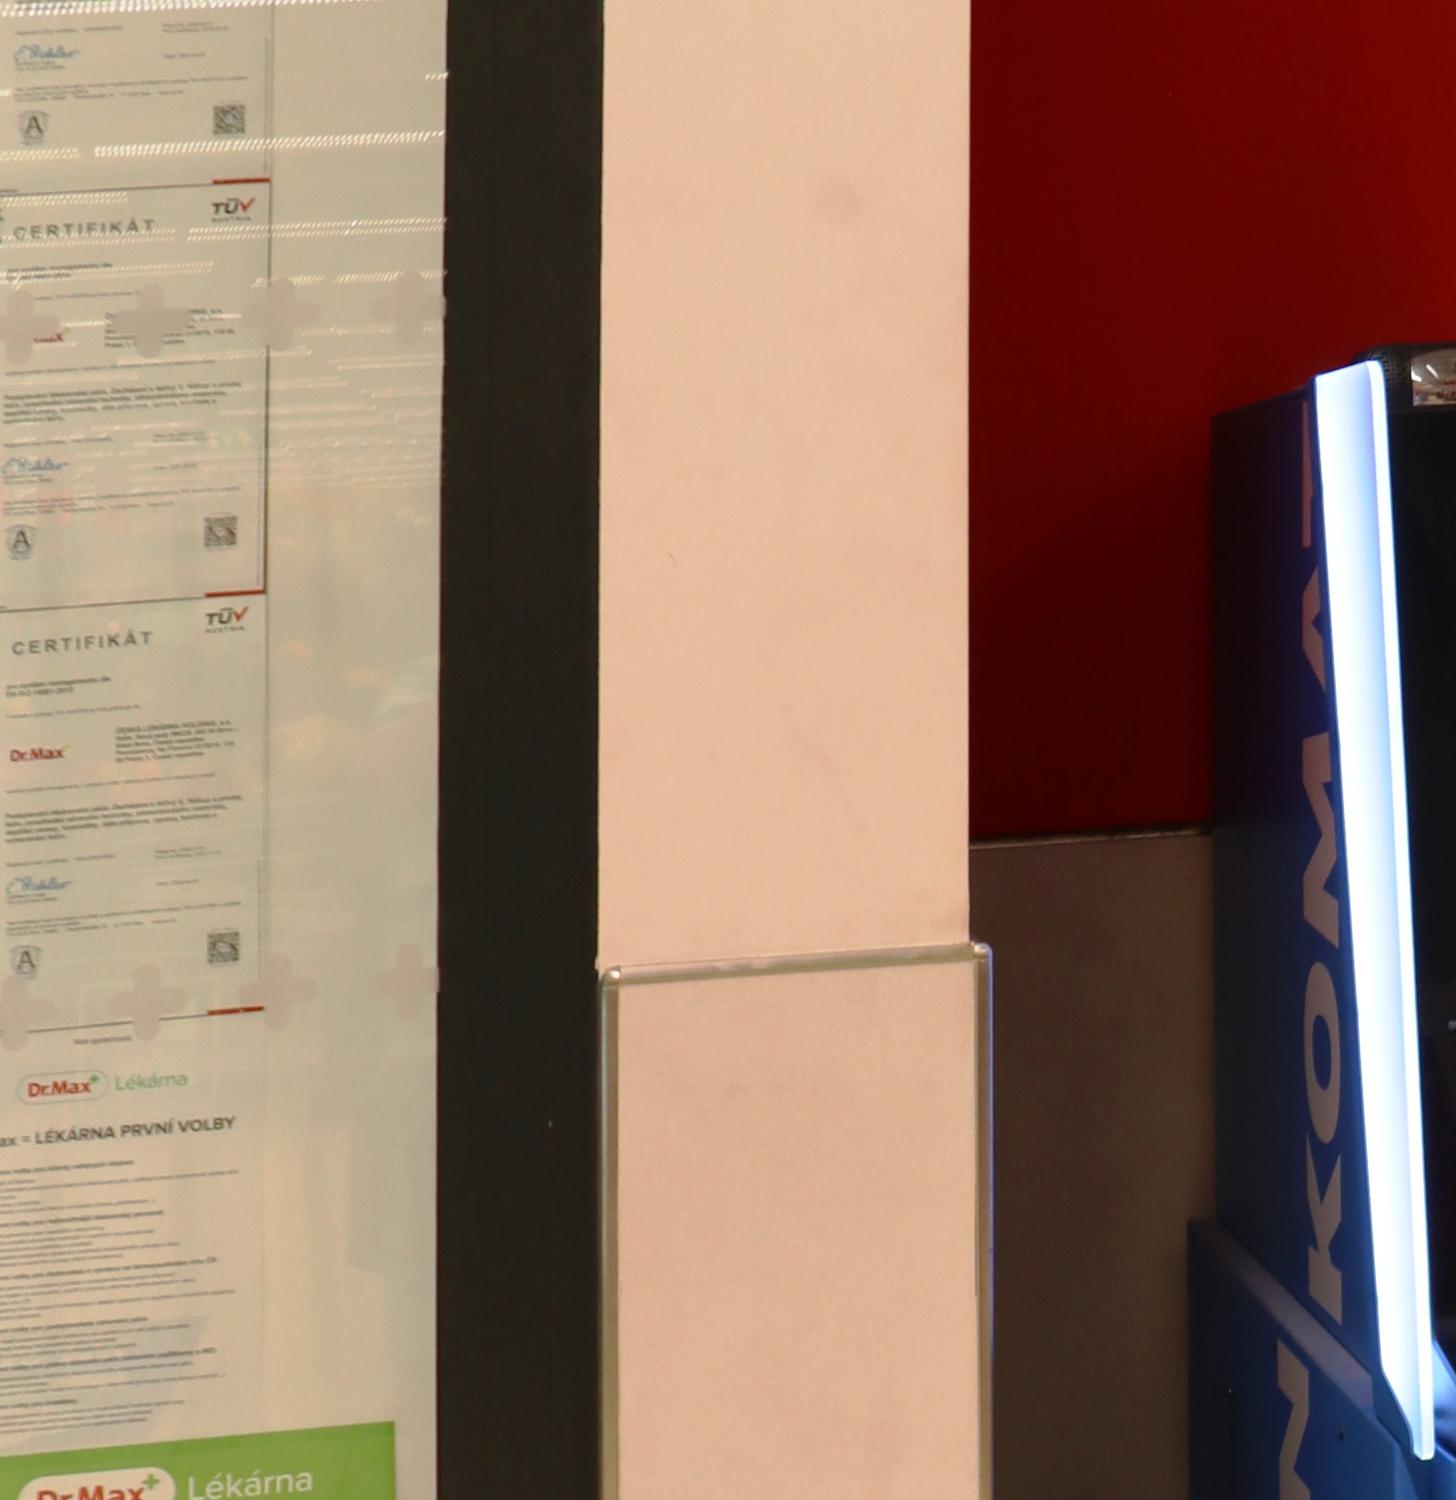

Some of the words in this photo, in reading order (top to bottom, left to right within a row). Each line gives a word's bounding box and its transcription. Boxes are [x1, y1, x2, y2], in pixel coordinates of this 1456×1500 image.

[13, 217, 156, 241] CERTIFIKÁT
[12, 629, 153, 656] CERTIFIKÁT
[10, 747, 64, 762] Dr.Max
[27, 1080, 91, 1098] Dr.Max
[115, 1073, 188, 1092] Lékárna
[35, 1126, 116, 1145] LÉKÁRNA
[120, 1118, 174, 1138] PRVNÍ
[177, 1116, 236, 1133] VOLBY
